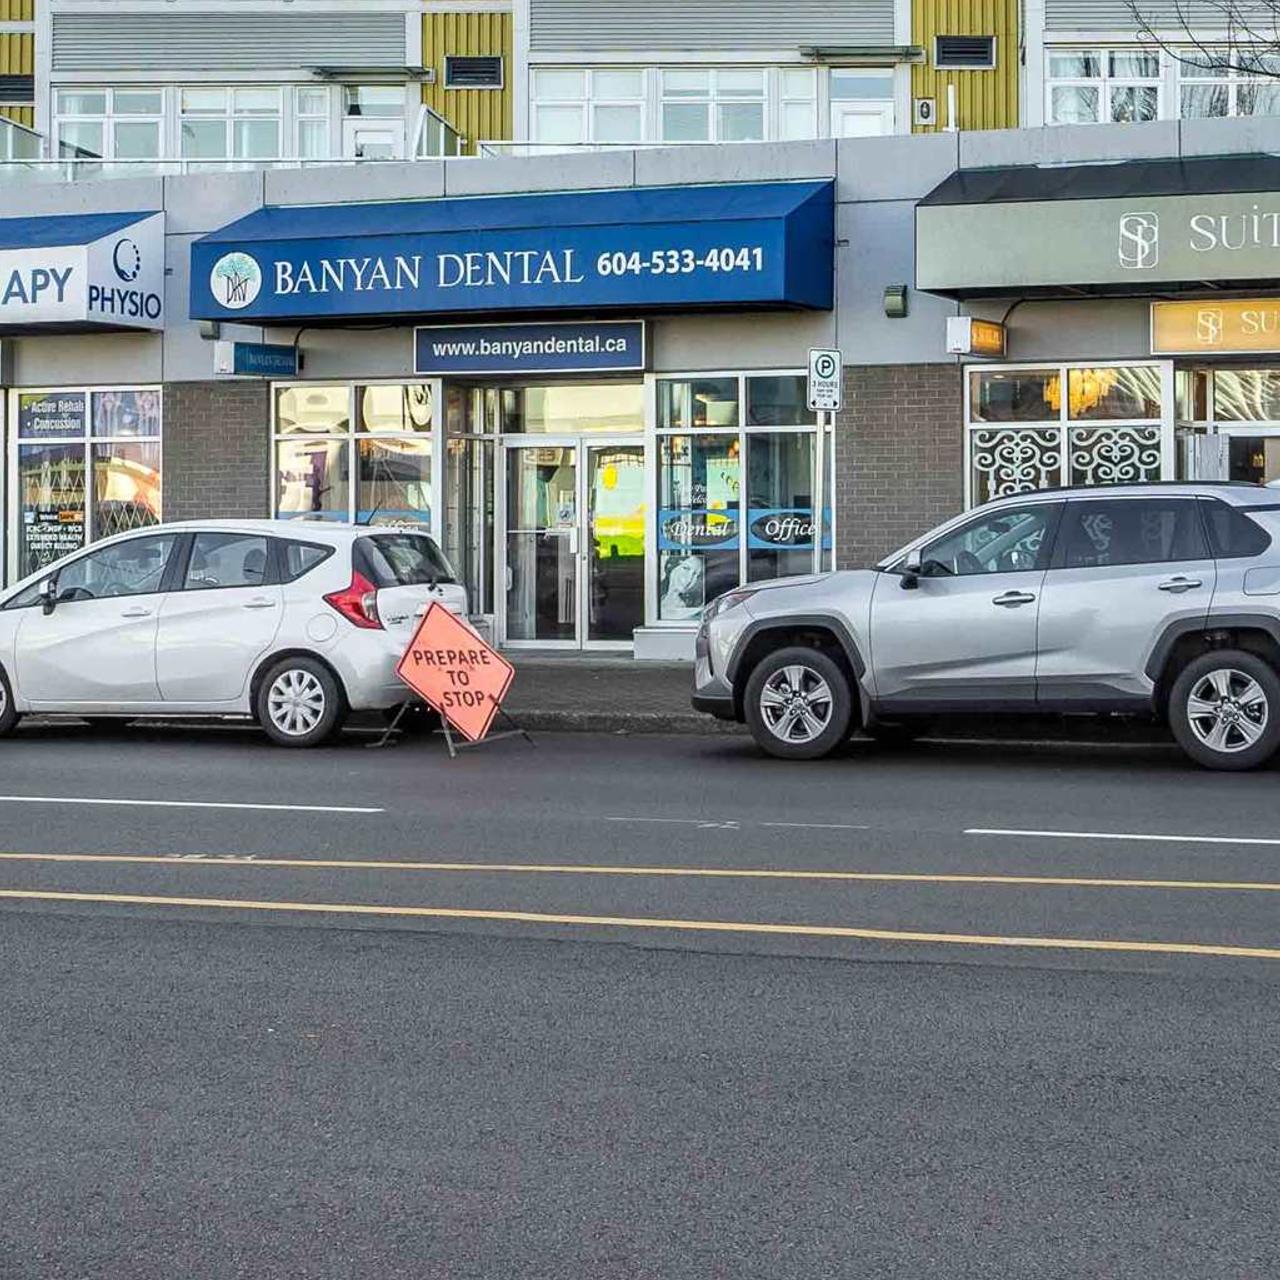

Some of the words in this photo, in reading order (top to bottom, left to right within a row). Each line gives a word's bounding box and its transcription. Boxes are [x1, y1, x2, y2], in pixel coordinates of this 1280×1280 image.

[274, 257, 420, 295] BANYAN
[437, 250, 584, 289] DENTAL
[597, 247, 763, 276] 604-533-4041
[88, 285, 162, 320] PHYSIO
[432, 334, 627, 359] www.banyandental.ca
[31, 400, 55, 413] Active
[58, 398, 84, 412] Rehab
[33, 418, 81, 430] Concussion
[671, 521, 728, 536] Dental
[765, 517, 817, 541] Office
[412, 649, 491, 666] PREPARE
[446, 670, 470, 686] TO
[442, 690, 485, 708] STOP
